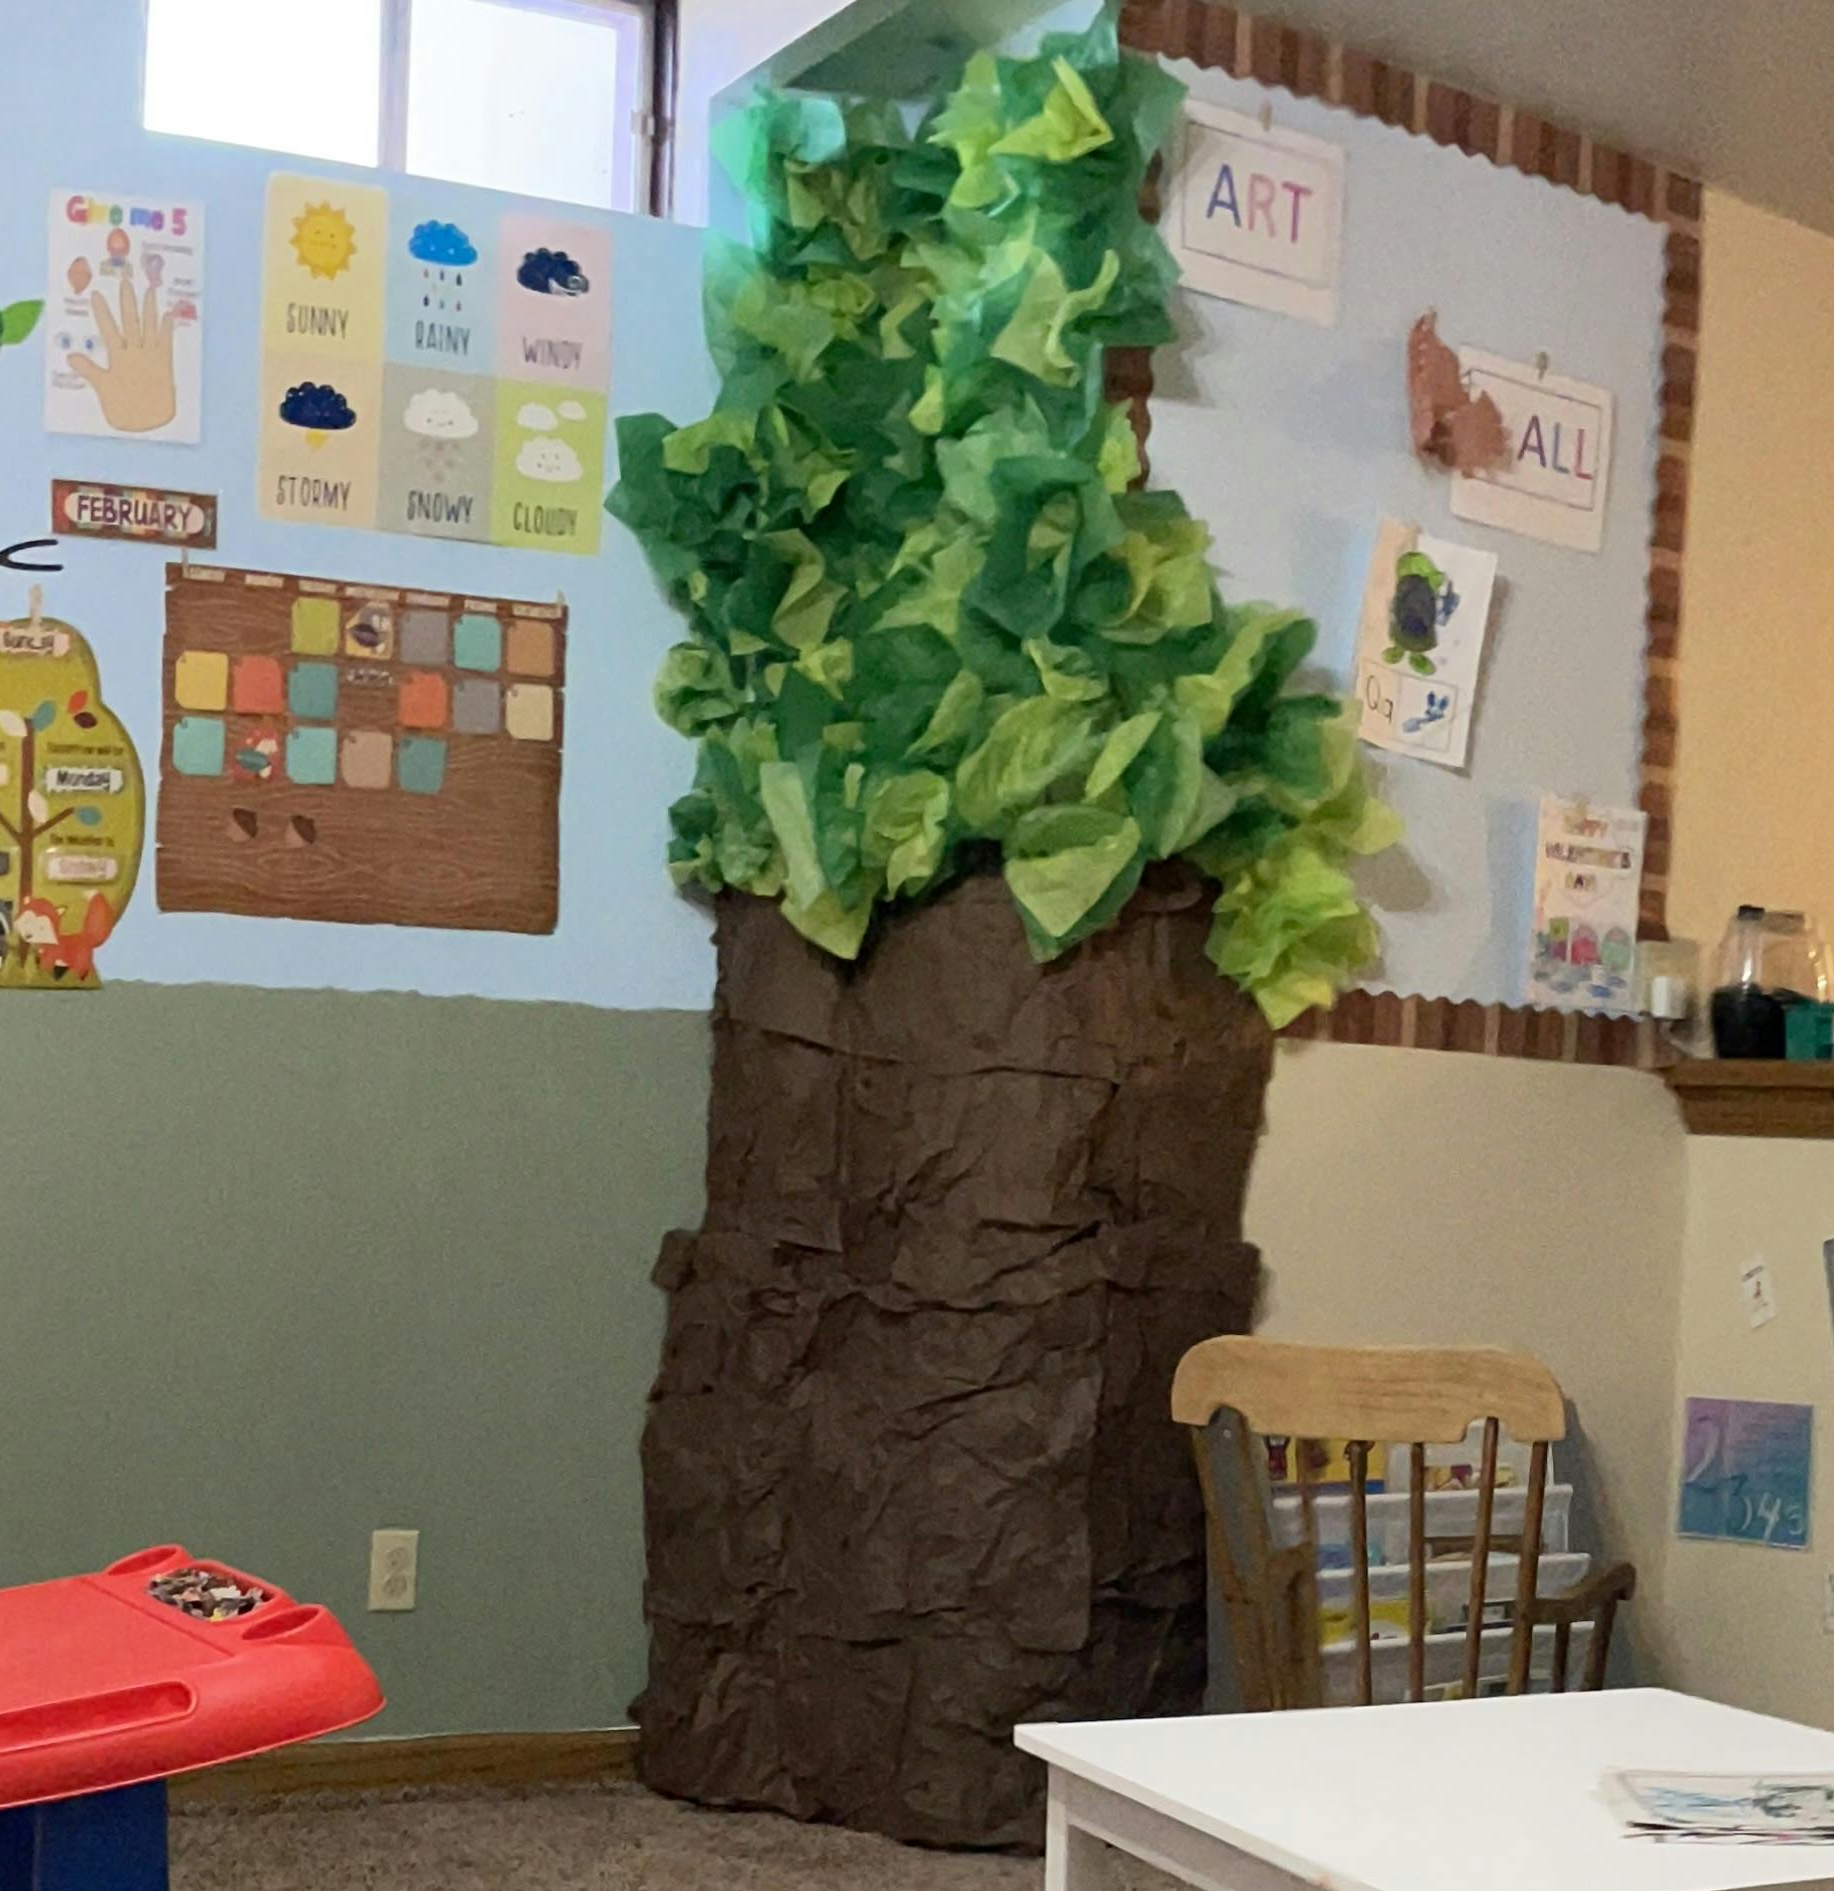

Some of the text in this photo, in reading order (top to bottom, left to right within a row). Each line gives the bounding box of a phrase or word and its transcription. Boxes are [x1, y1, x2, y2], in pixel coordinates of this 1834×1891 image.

[1206, 164, 1313, 243] ART
[172, 208, 187, 236] 5
[286, 303, 350, 338] SUNNY
[415, 320, 471, 355] RAINY
[522, 337, 582, 370] WINDY
[1517, 415, 1594, 481] ALL
[276, 475, 352, 509] STORMY
[407, 490, 474, 523] SNOWY
[76, 495, 192, 531] FEBRUARY
[513, 502, 578, 536] CLOUDY
